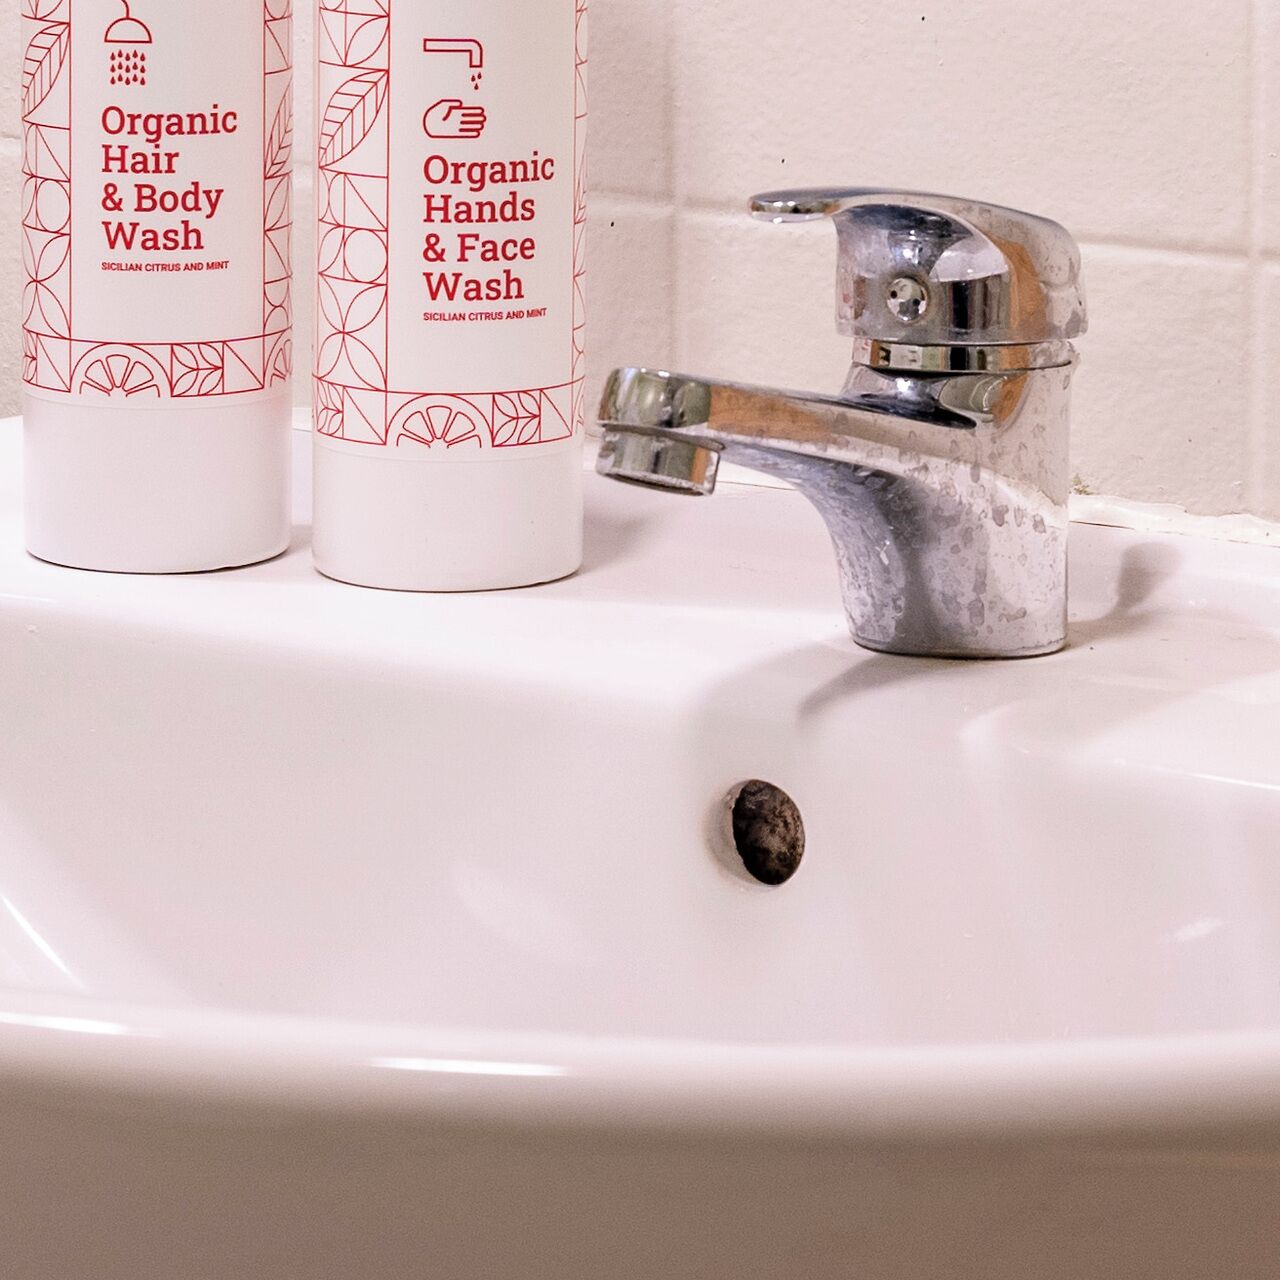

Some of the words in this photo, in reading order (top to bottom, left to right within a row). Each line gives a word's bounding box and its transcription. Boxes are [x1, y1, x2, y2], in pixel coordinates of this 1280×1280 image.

[101, 103, 238, 144] Organic
[101, 144, 180, 174] Hair
[423, 150, 554, 192] Organic
[101, 182, 124, 212] &
[133, 181, 224, 219] Body
[423, 191, 536, 223] Hands
[101, 220, 204, 251] Wash
[422, 232, 446, 263] &
[456, 232, 536, 263] Face
[101, 261, 142, 271] SICILIAN
[144, 261, 181, 272] CITRUS
[183, 260, 204, 271] AND
[206, 260, 229, 270] MINT
[422, 269, 524, 302] Wash
[423, 312, 466, 322] SICILIAN
[468, 311, 504, 321] CITRUS
[505, 310, 525, 320] AND
[526, 307, 547, 319] MINT
